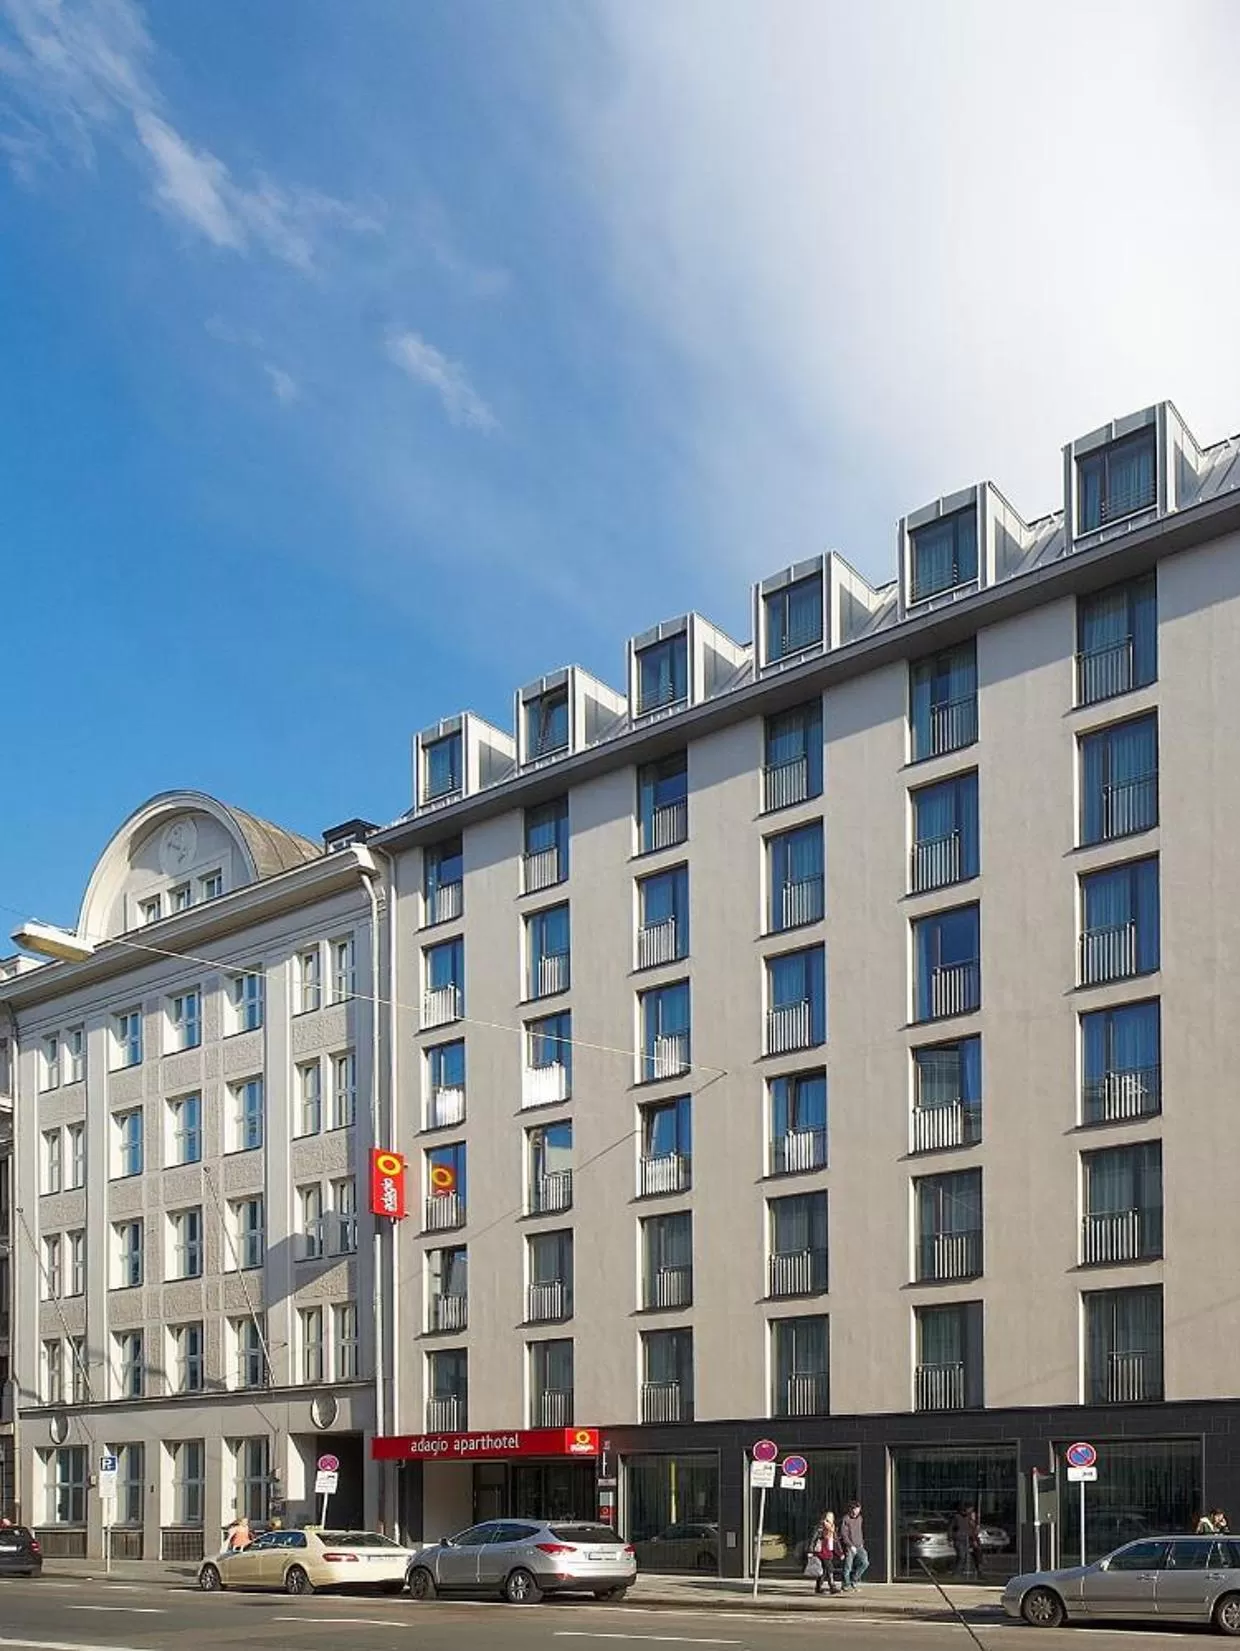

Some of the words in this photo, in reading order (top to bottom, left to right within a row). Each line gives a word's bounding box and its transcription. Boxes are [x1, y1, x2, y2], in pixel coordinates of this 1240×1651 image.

[381, 1178, 397, 1212] adagio
[411, 1437, 448, 1456] adagio
[453, 1433, 520, 1455] aparthotel
